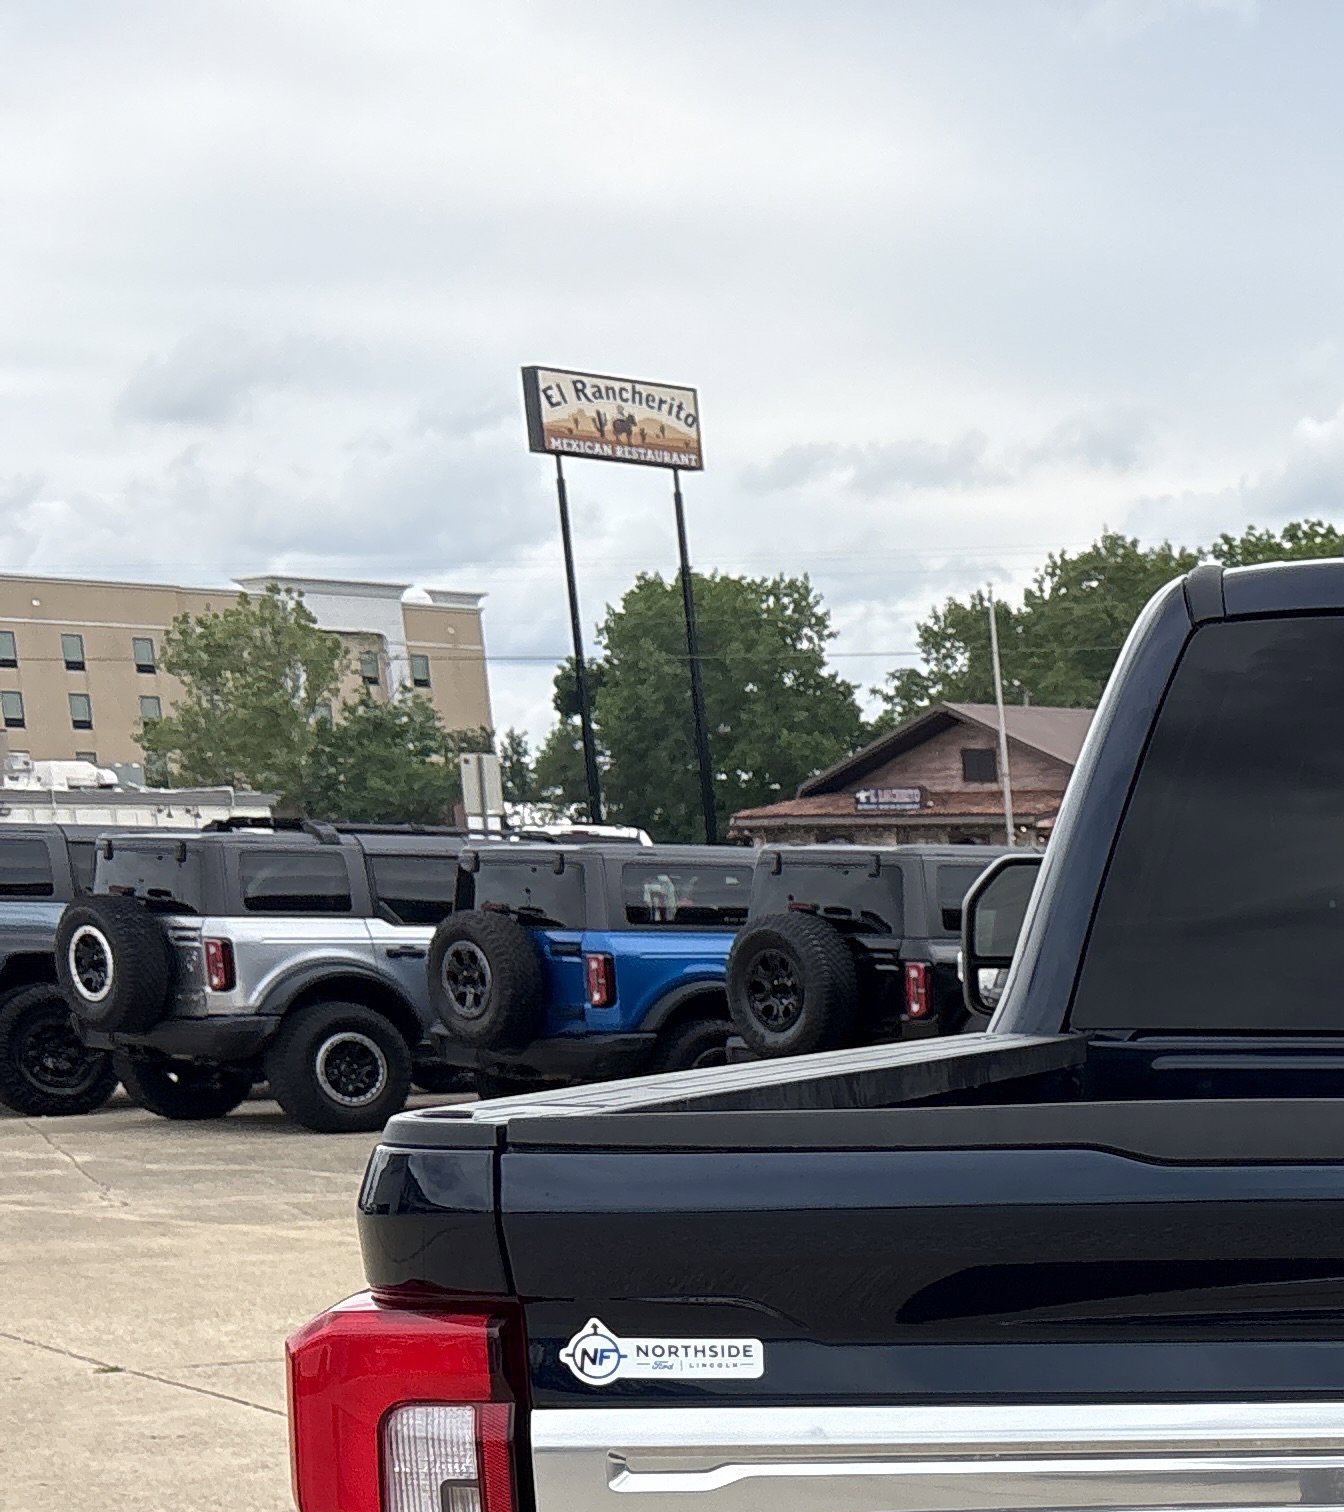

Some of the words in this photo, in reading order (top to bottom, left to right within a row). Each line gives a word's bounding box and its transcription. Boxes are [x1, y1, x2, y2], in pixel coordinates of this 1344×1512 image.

[542, 383, 568, 408] El
[572, 379, 697, 428] Rancherito
[550, 437, 612, 455] MEXICAN
[615, 444, 697, 466] RESTAURANT
[581, 1347, 618, 1372] NF
[636, 1344, 753, 1358] NORTHSIDE
[652, 1361, 674, 1370] Ford
